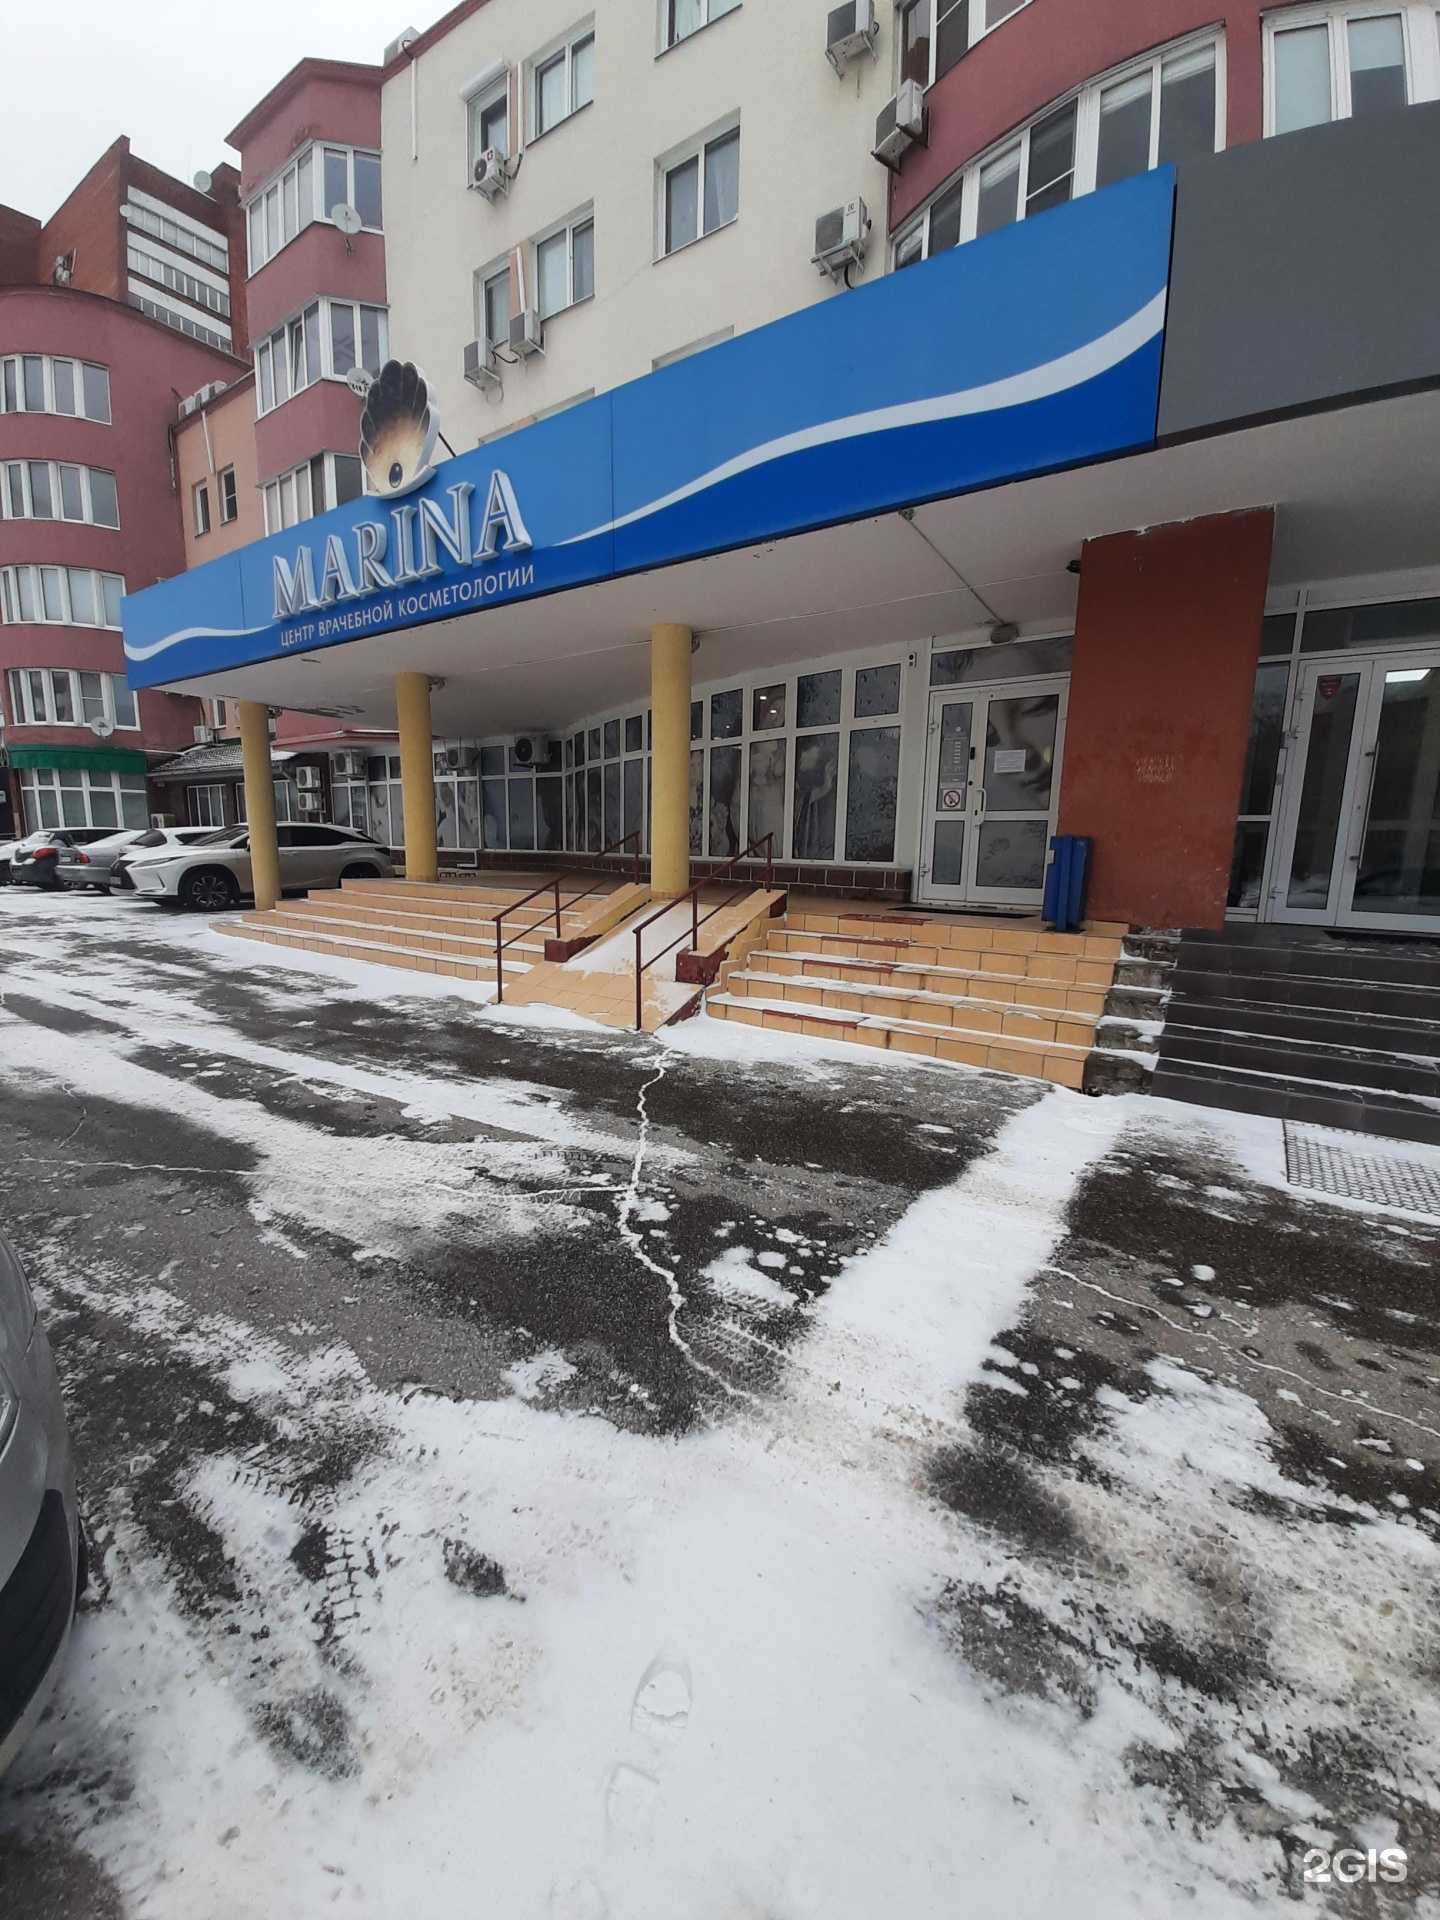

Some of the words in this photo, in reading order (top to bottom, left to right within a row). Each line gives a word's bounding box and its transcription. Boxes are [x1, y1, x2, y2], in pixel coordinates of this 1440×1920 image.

[273, 470, 533, 620] MARINA
[281, 624, 315, 647] ЦЕНТР
[319, 600, 393, 637] ВРАЧЕБНОЙ
[399, 565, 534, 616] КОСМЕТОЛОГИИ
